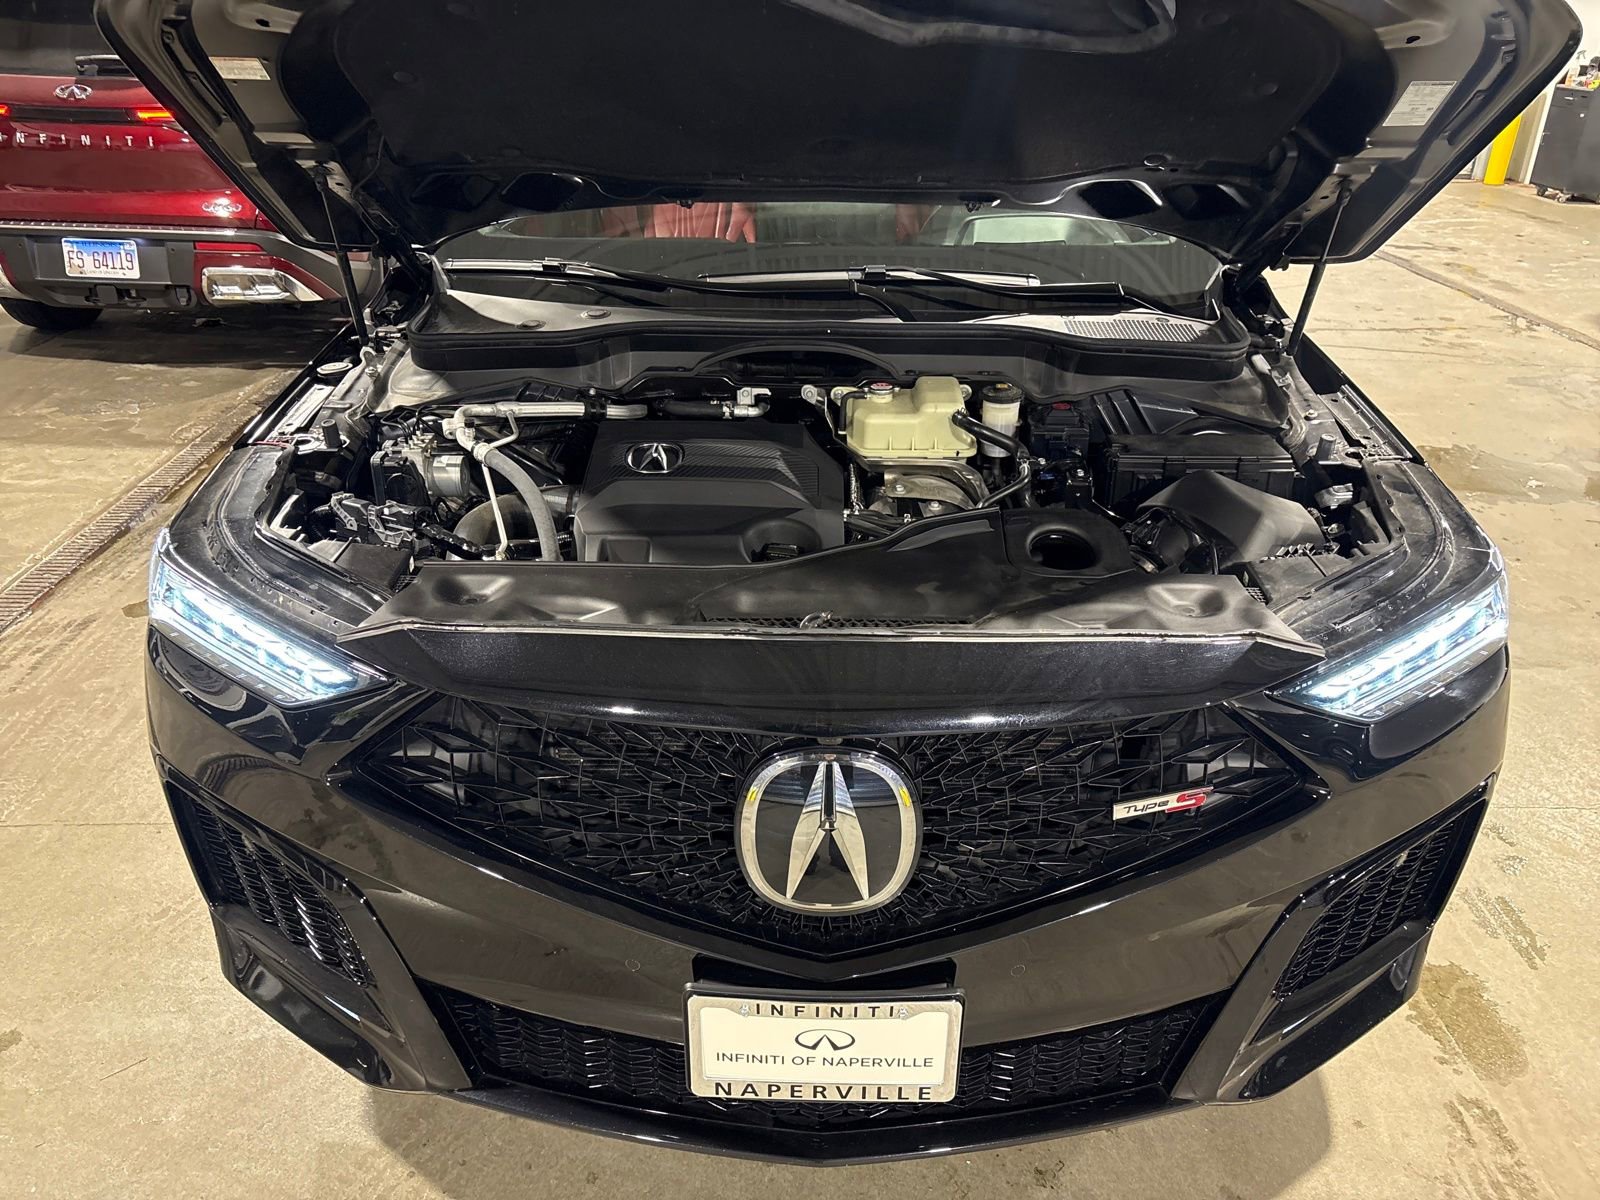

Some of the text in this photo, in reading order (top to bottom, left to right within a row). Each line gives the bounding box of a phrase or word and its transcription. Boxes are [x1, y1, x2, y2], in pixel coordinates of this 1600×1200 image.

[67, 250, 134, 271] FS 64119
[1165, 786, 1214, 814] S
[756, 1003, 895, 1018] INFINITI
[716, 1052, 934, 1068] INFINITI OF NAPERVILLE
[715, 1082, 932, 1101] NAPERVILLE
